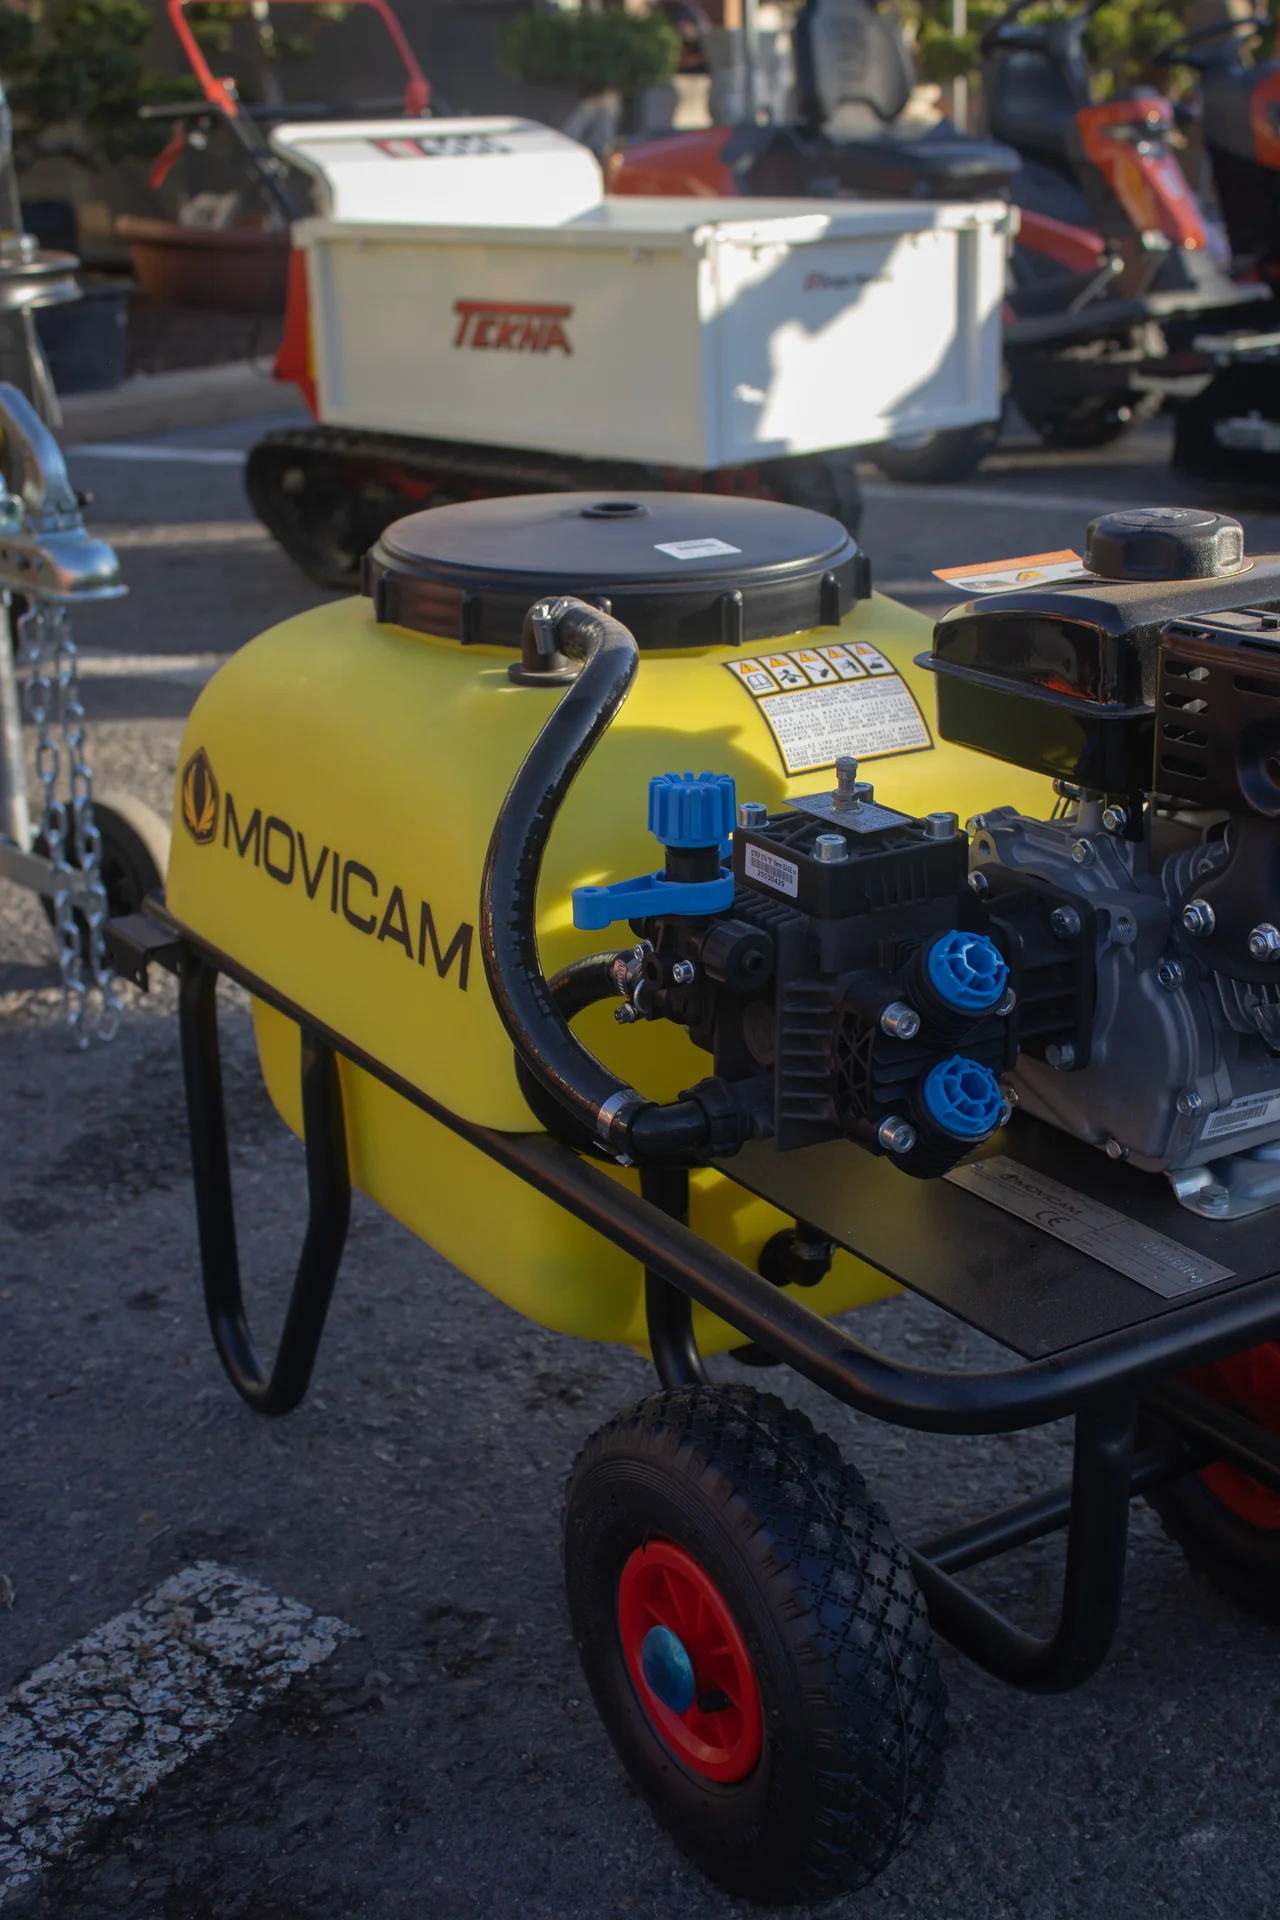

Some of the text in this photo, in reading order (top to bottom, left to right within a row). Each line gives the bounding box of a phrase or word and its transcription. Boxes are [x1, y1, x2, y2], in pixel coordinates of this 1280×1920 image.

[454, 300, 574, 356] TEKNA
[223, 791, 474, 993] MOVICAM
[1014, 1180, 1084, 1215] MOVICAM
